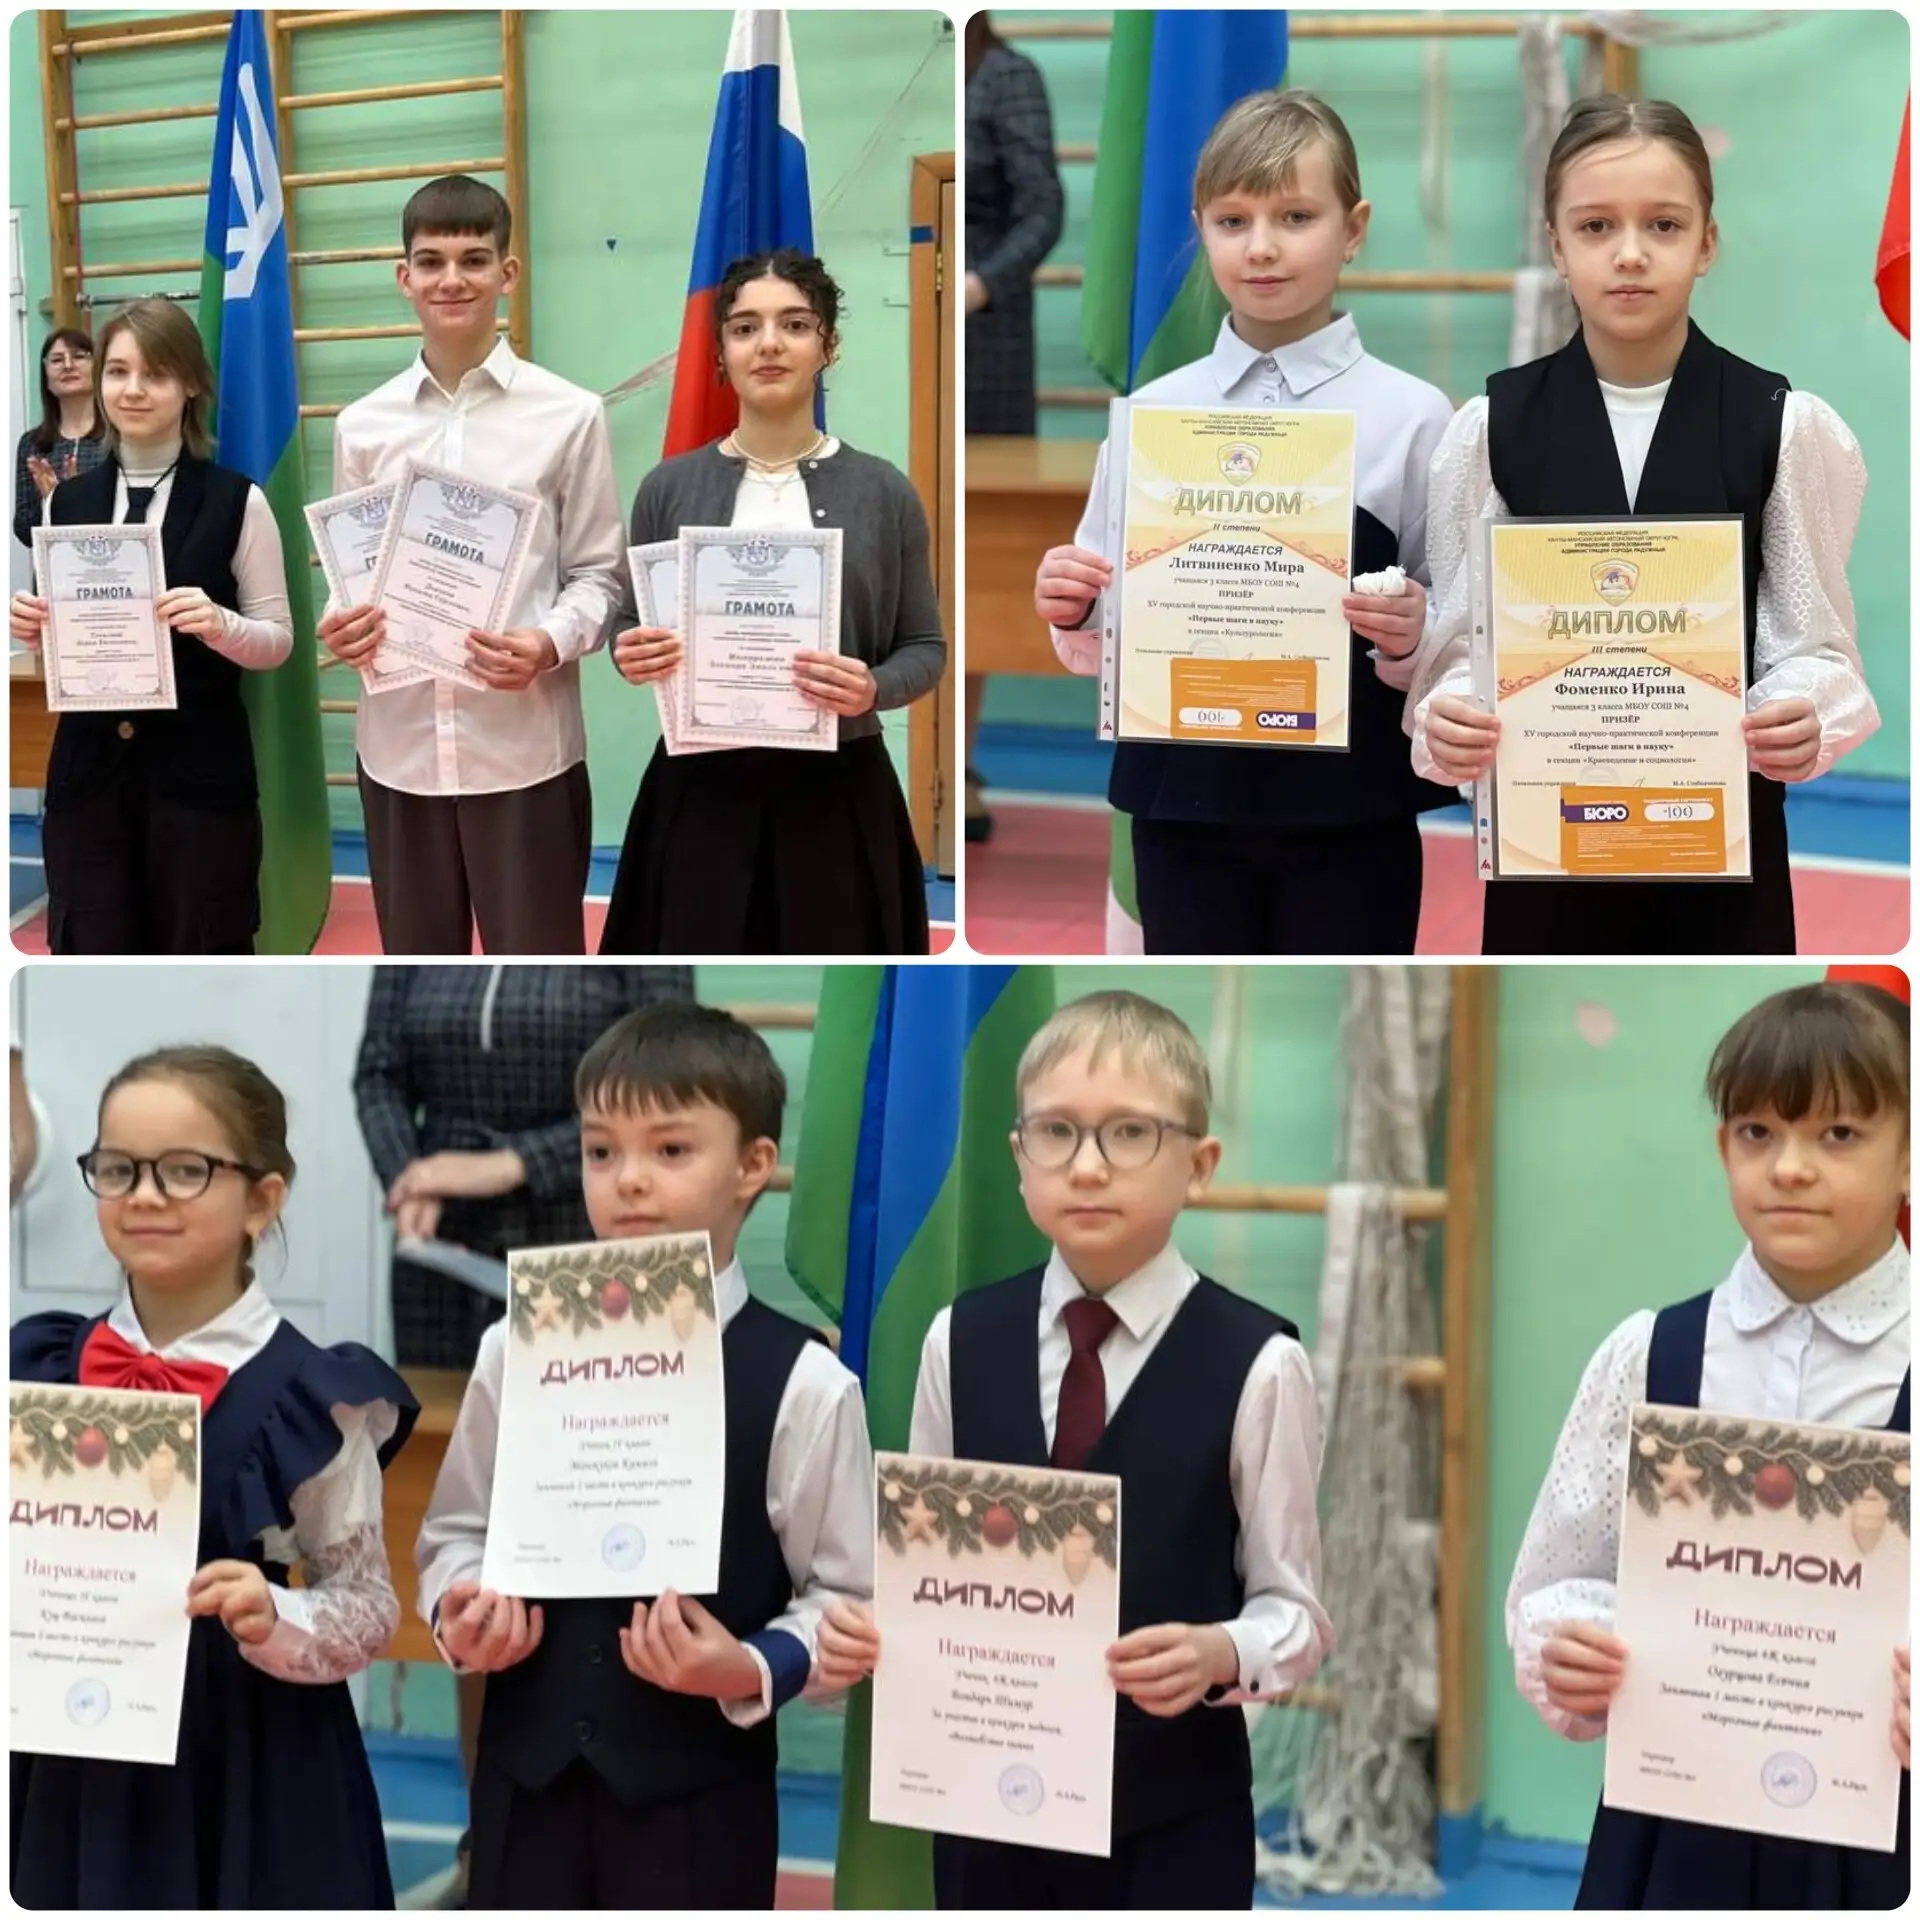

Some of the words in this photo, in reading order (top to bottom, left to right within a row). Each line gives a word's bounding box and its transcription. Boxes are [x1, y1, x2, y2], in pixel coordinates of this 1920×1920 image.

[1173, 488, 1302, 516] ДИПЛОМ
[1222, 523, 1261, 533] степени
[424, 532, 485, 564] ГРАМОТА
[1187, 542, 1283, 556] НАГРАЖДАЕТСЯ
[1168, 556, 1261, 572] Литвиненко
[1264, 559, 1305, 575] Мира
[1240, 578, 1262, 586] МБОУ
[1264, 579, 1284, 587] СОШ
[76, 586, 133, 599] ГРАМОТА
[1218, 589, 1254, 599] ПРИЗЁР
[724, 600, 795, 616] ГРАМОТА
[1548, 610, 1686, 639] ДИПЛОМ
[1592, 645, 1603, 654] III
[1605, 645, 1648, 655] степени
[1563, 666, 1671, 679] НАГРАЖДАЕТСЯ
[1554, 683, 1628, 697] Фоменко
[1632, 683, 1686, 698] Ирина
[1591, 703, 1597, 712] 3
[1597, 703, 1623, 711] класса
[1651, 702, 1672, 710] СОШ
[1258, 713, 1298, 727] БЮРО
[1601, 714, 1641, 724] ПРИЗЁР
[1569, 742, 1609, 752] «Первые
[1611, 743, 1634, 751] шаги
[1643, 743, 1674, 752] науку»
[1584, 807, 1627, 820] БЮРО
[539, 1350, 685, 1386] ДИПЛОМ
[562, 1411, 670, 1434] Награждается
[9, 1499, 158, 1535] ДИПЛОМ
[24, 1558, 137, 1584] Награждается
[1665, 1539, 1863, 1590] ДИПЛОМ
[912, 1576, 1075, 1619] ДИПЛОМ
[1694, 1607, 1837, 1645] Награждается
[938, 1637, 1056, 1669] Награждается
